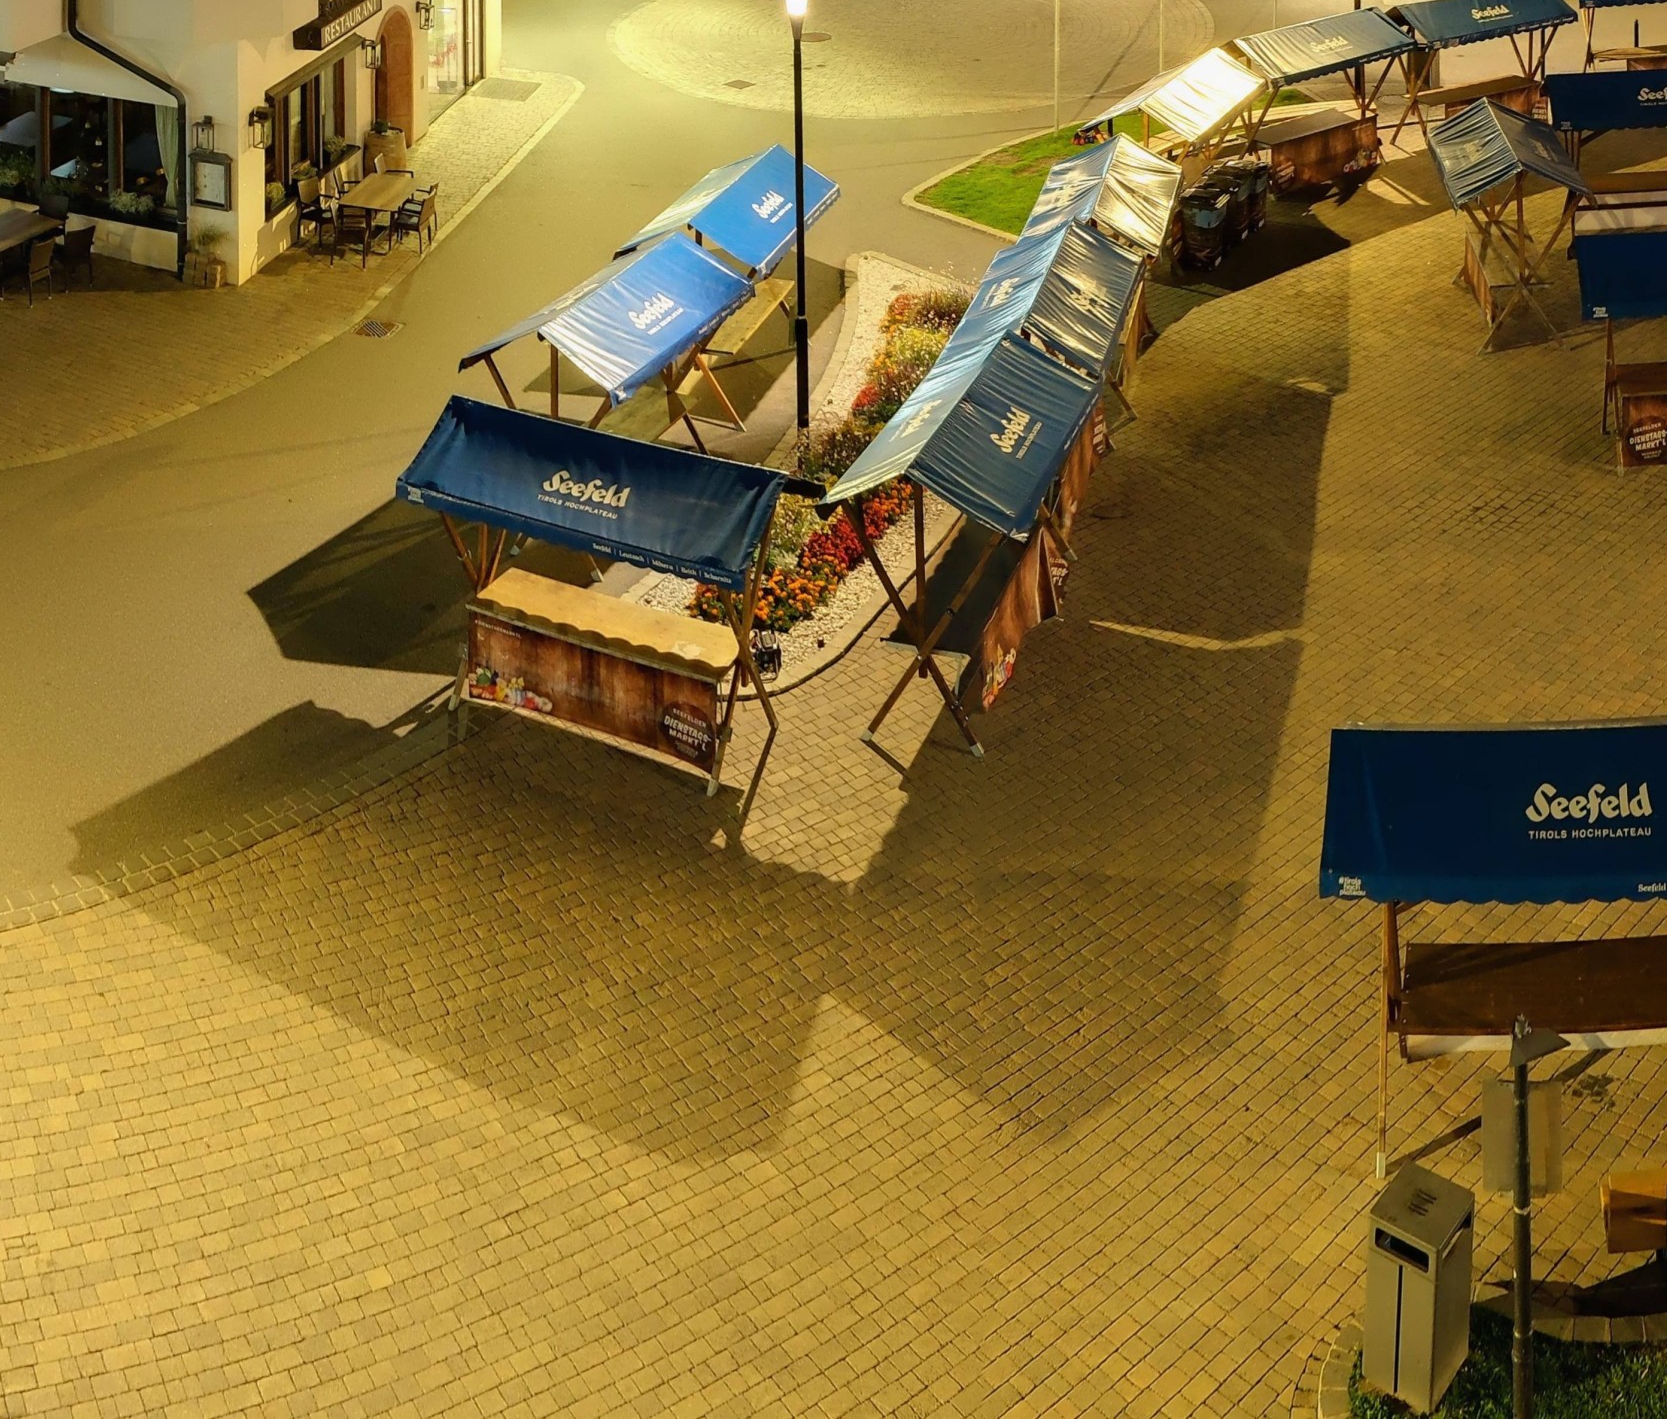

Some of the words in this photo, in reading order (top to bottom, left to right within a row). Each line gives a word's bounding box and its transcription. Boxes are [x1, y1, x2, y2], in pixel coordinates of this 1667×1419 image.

[1472, 4, 1510, 19] Seefeld
[752, 190, 784, 219] Seefeld
[627, 293, 675, 330] Seefeld
[990, 406, 1031, 454] Seefeld
[543, 470, 631, 508] Seefeld
[537, 493, 563, 507] TIROLS
[565, 500, 618, 520] HOCHPLATEAU
[673, 708, 707, 728] SEEFELDER
[1525, 783, 1653, 823] Seefeld
[1528, 829, 1567, 840] TIROLS
[1571, 826, 1652, 839] HOCHPLATEAU
[1338, 876, 1362, 885] #tirols
[1343, 883, 1360, 891] hoch
[1638, 882, 1666, 892] Seefeld
